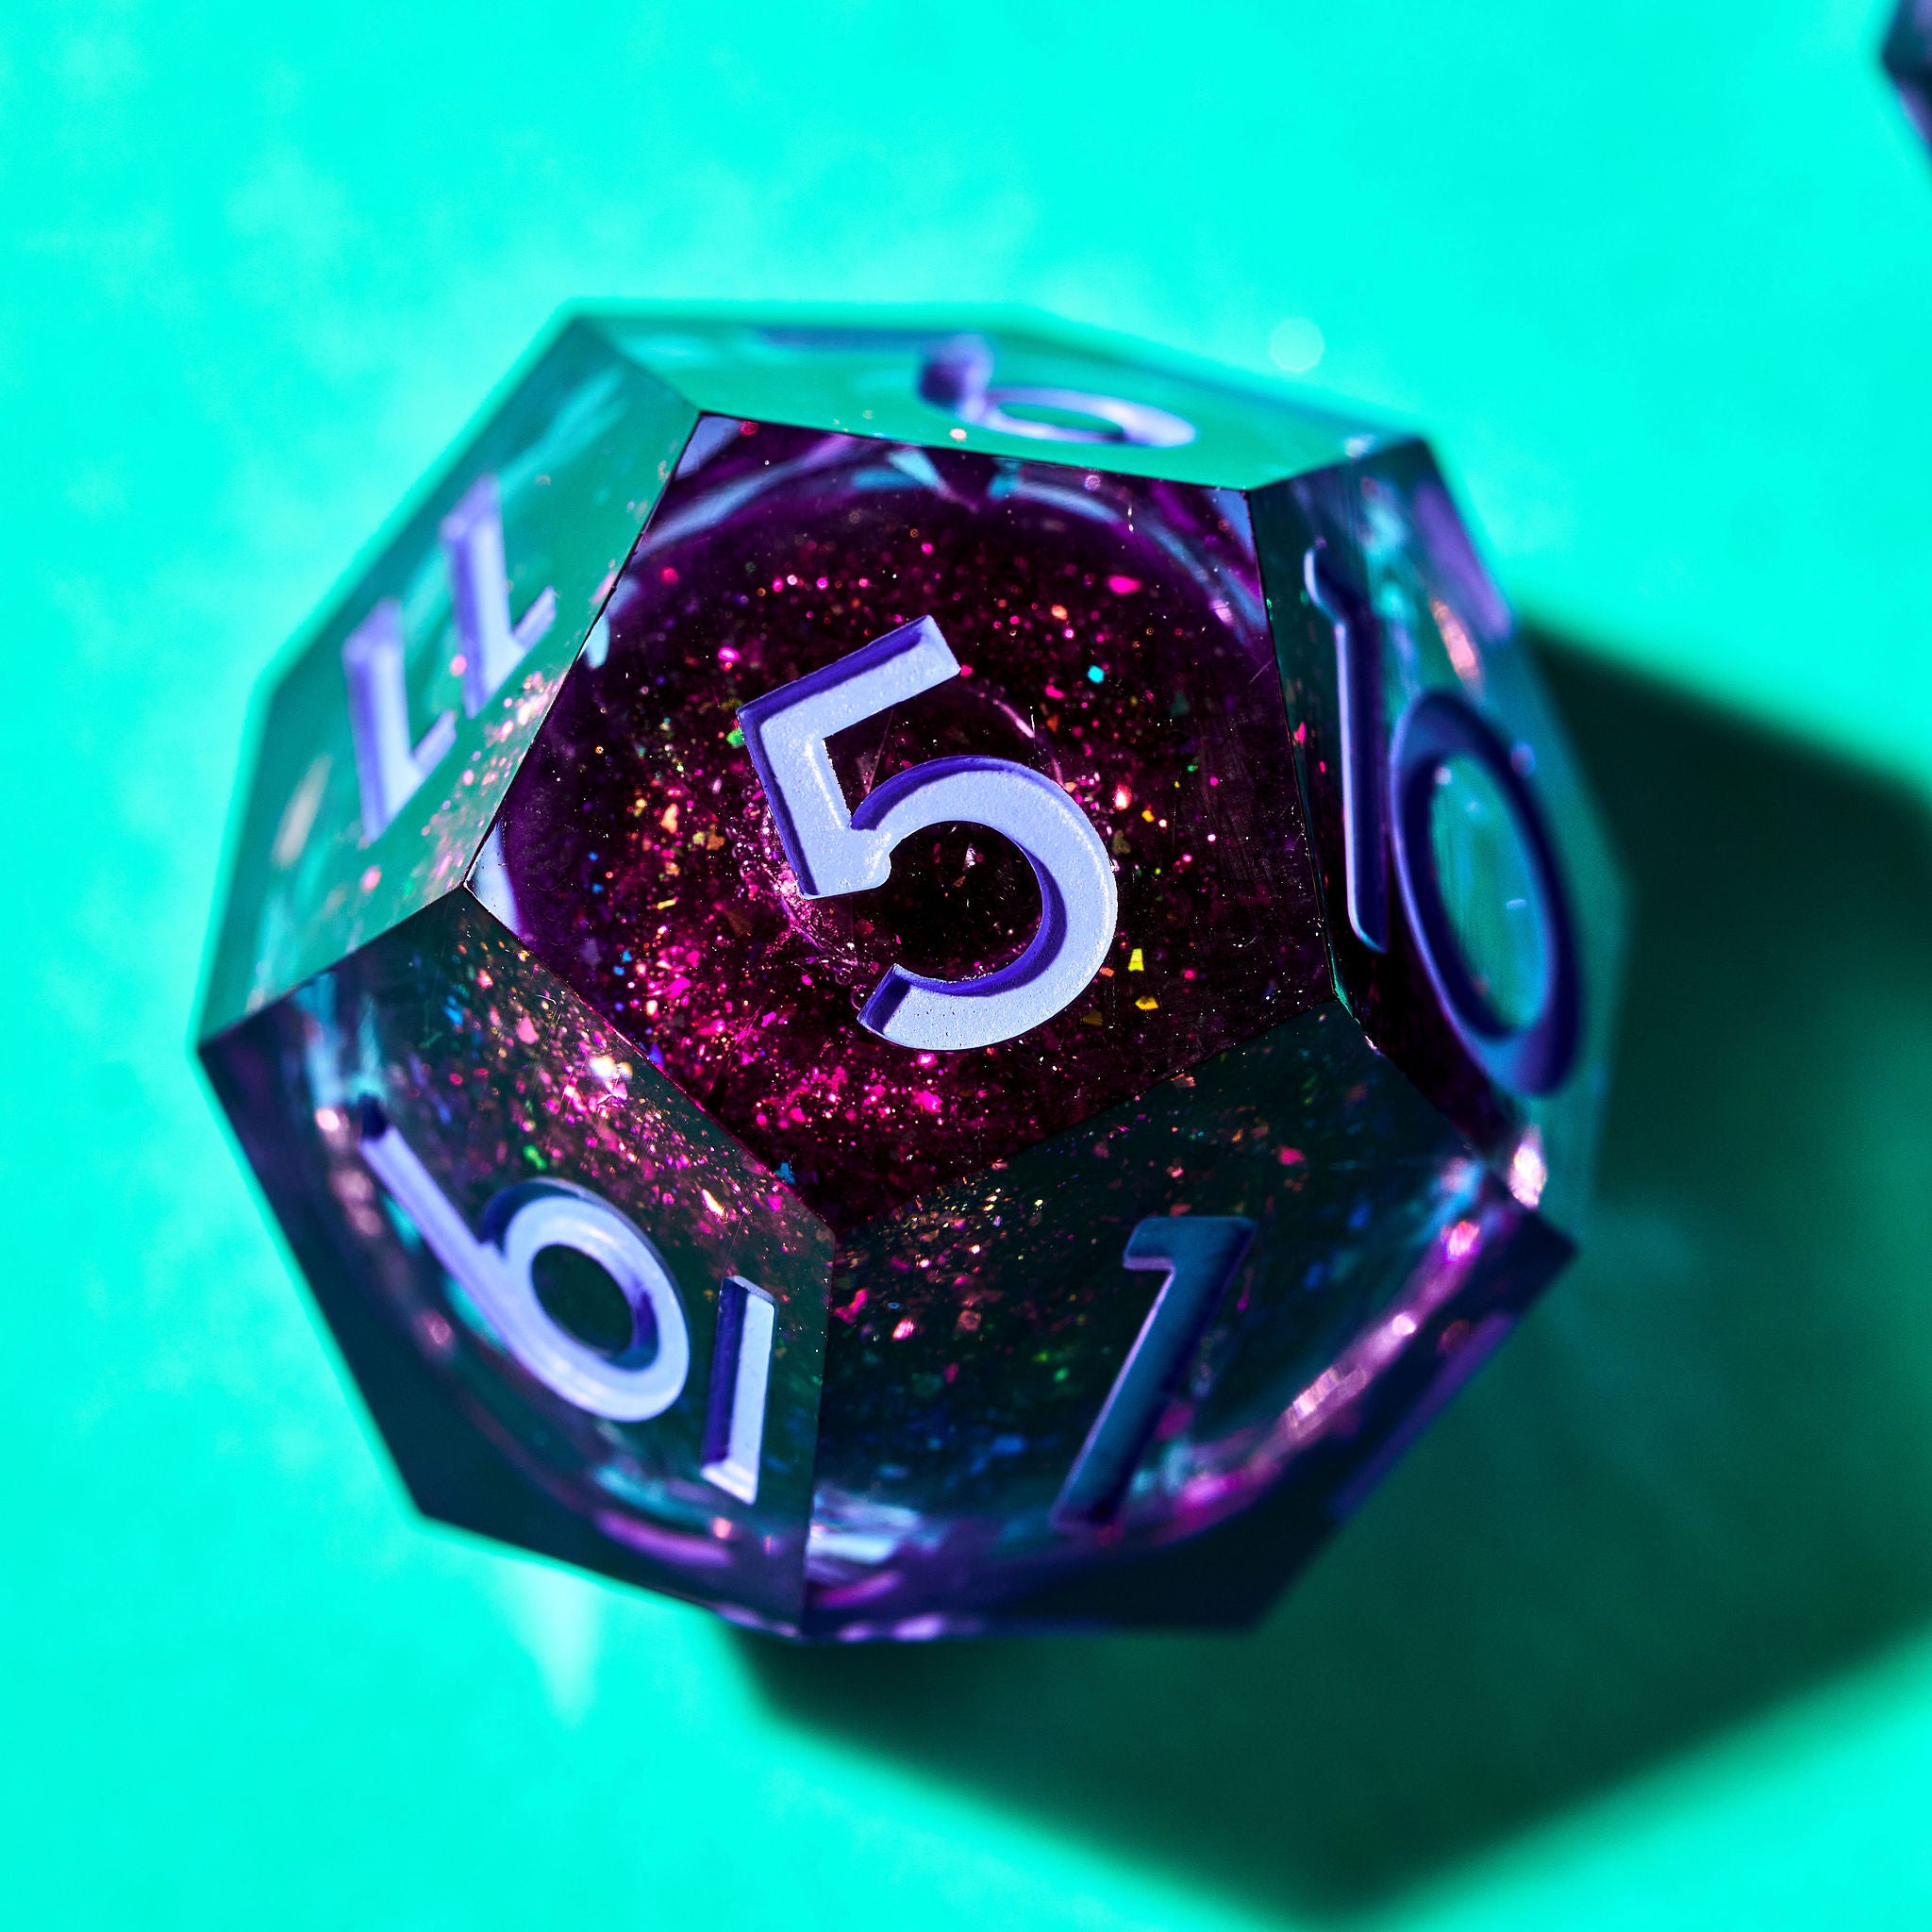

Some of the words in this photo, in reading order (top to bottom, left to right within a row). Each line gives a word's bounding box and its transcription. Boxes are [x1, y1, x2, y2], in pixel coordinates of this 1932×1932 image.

[341, 472, 558, 842] 11
[736, 614, 1120, 1052] 5
[1304, 547, 1585, 1097] 10
[357, 1094, 691, 1423] 6
[1049, 1215, 1257, 1530] 1
